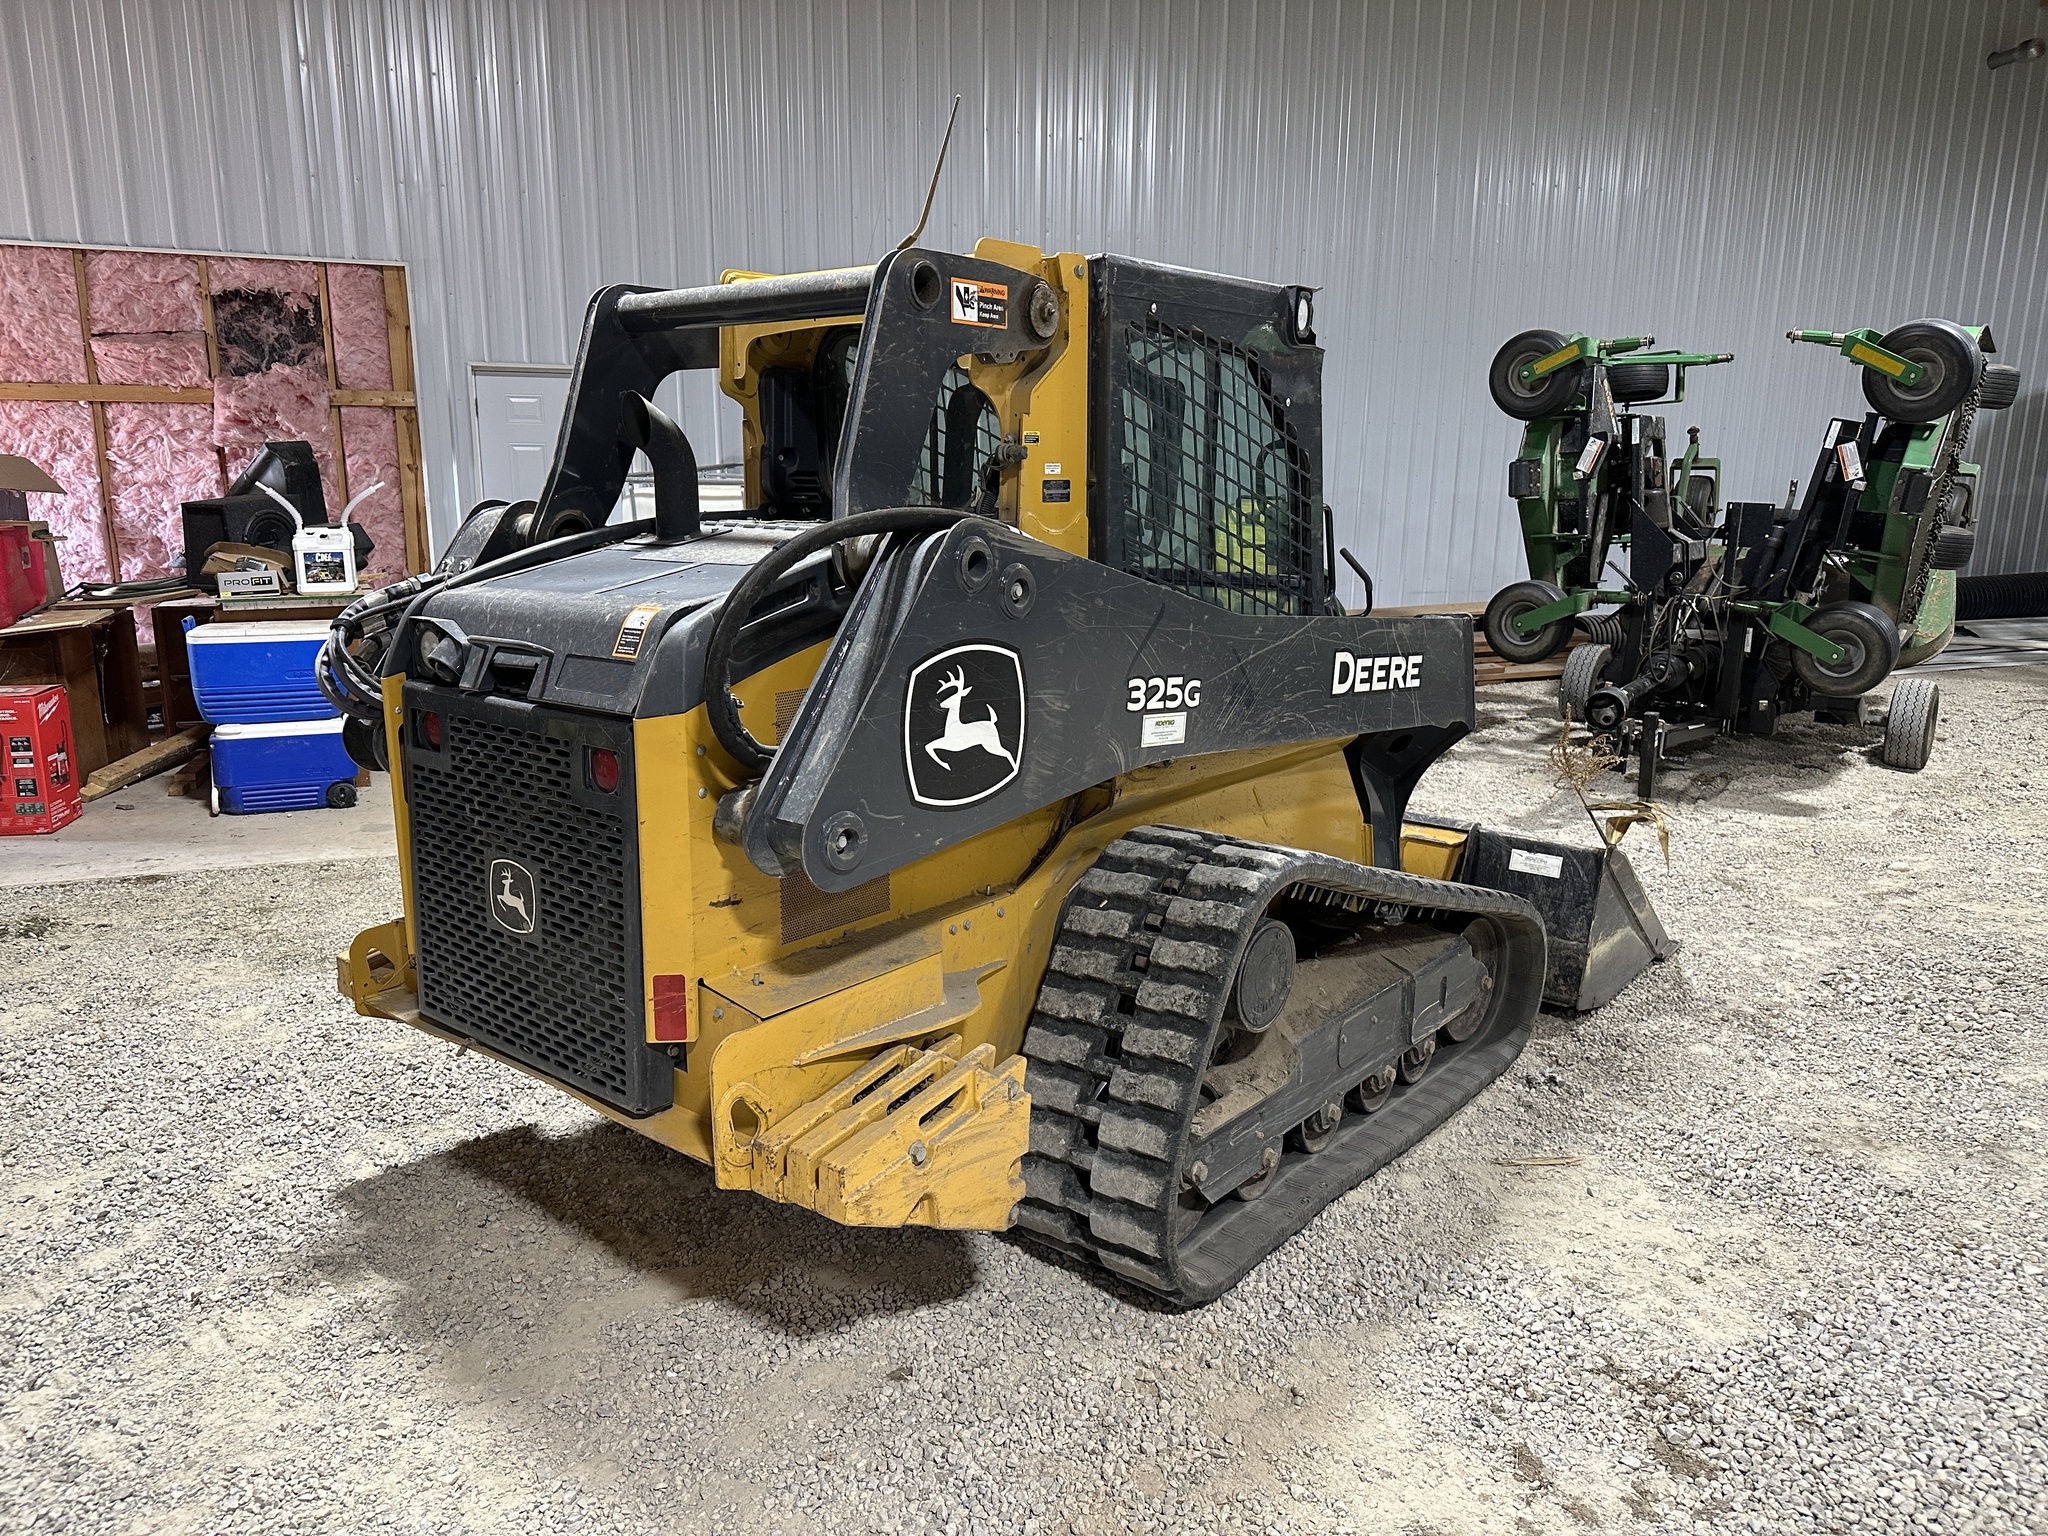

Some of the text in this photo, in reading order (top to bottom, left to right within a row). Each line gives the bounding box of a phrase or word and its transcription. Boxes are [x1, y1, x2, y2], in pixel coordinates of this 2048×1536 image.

[979, 302, 993, 310] Pinch
[224, 576, 272, 587] PROFIT
[1332, 651, 1423, 695] DEERE
[1127, 676, 1202, 712] 325G
